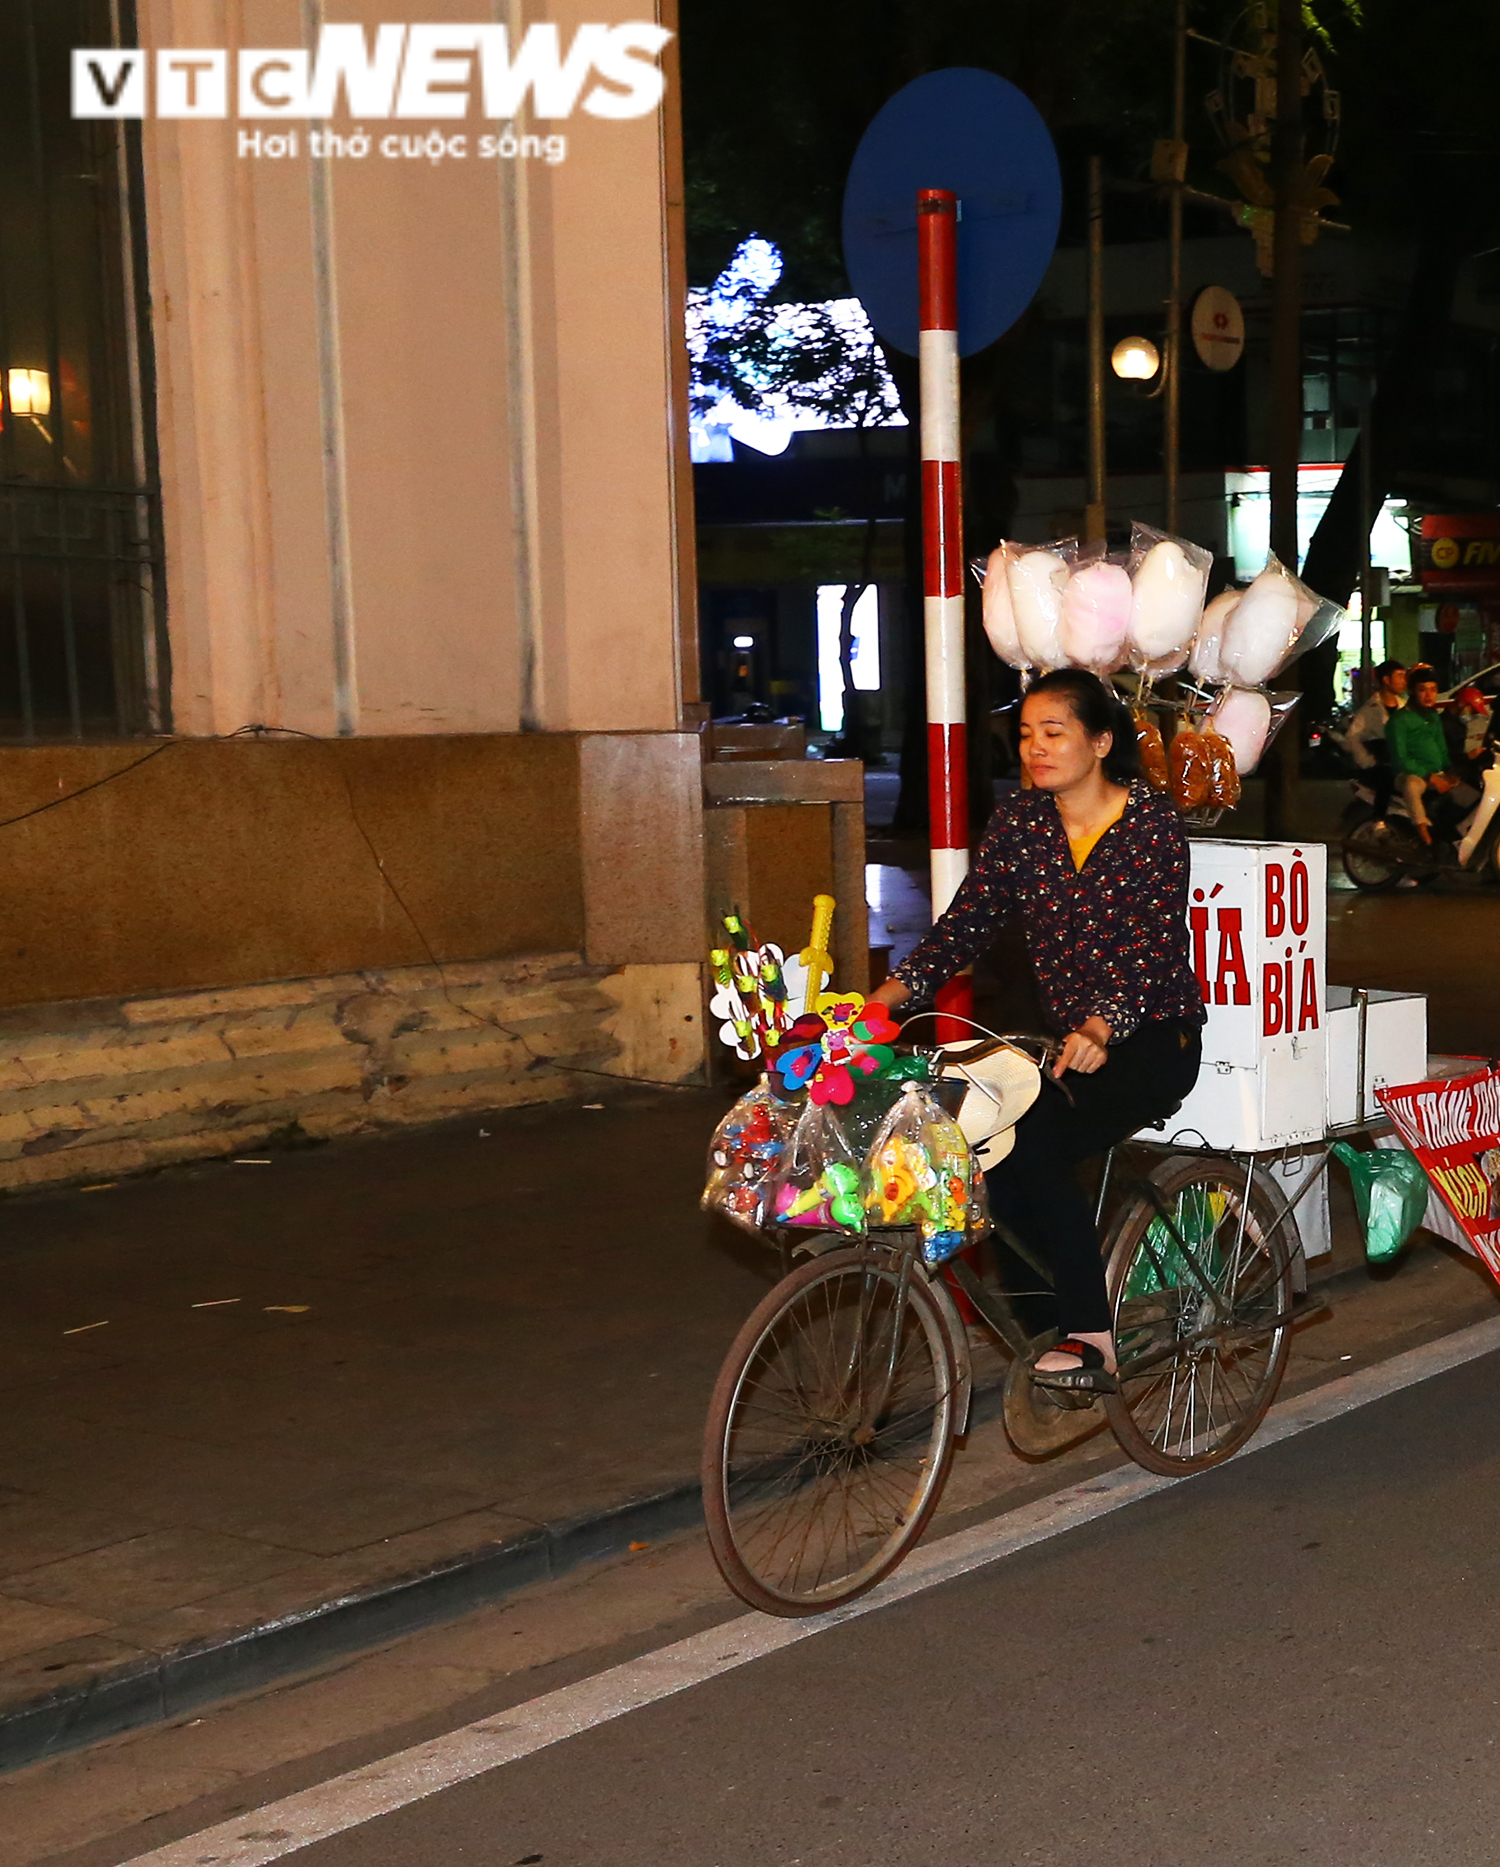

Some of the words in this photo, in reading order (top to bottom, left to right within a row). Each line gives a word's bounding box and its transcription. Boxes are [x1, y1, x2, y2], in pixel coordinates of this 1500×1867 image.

[1264, 848, 1309, 938] BÒ
[1189, 882, 1252, 1006] ÍA
[1262, 940, 1320, 1037] BÍA
